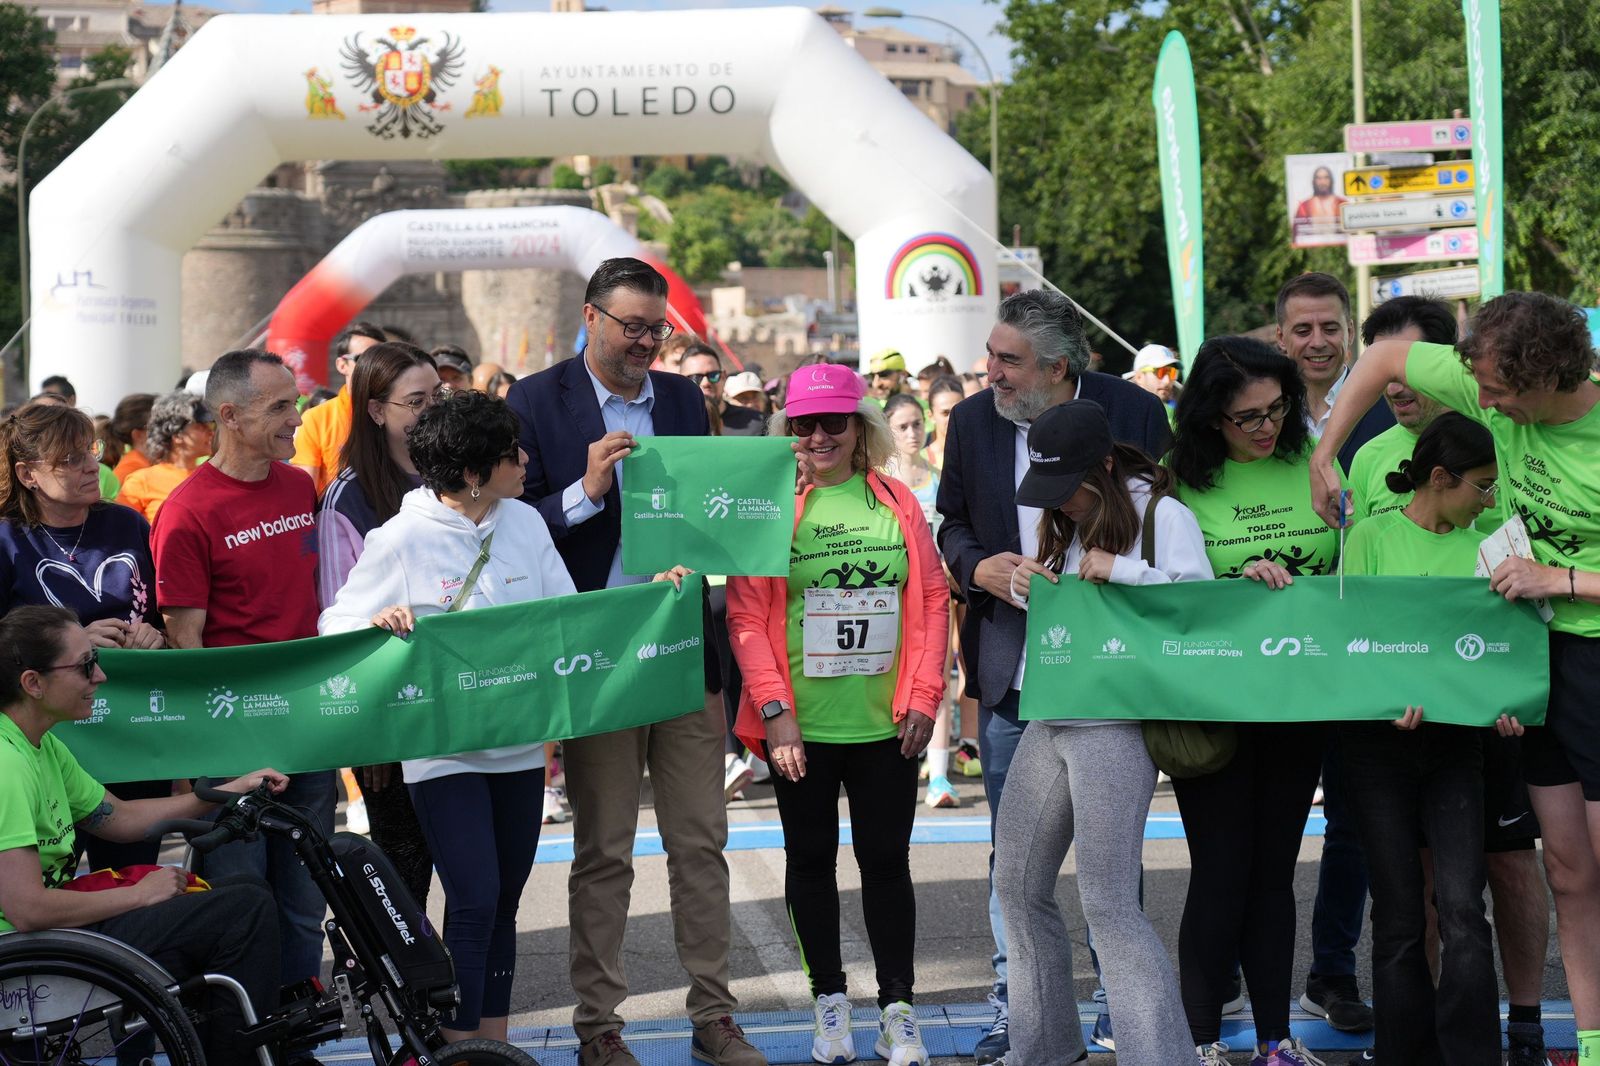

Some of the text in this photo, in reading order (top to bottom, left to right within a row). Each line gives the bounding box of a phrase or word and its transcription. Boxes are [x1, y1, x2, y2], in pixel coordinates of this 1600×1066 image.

[540, 62, 733, 79] AYUNTAMIENTO DE
[540, 84, 735, 117] TOLEDO
[511, 234, 561, 257] 2024
[1238, 506, 1293, 521] UNIVERSO MUJER
[1534, 495, 1544, 505] LA
[1545, 500, 1591, 519] IGUALDAD
[634, 511, 663, 519] Castilla-La
[817, 528, 849, 540] UNIVERSO
[1246, 522, 1286, 534] TOLEDO
[224, 526, 261, 549] new
[1216, 537, 1251, 547] FORMA
[1253, 533, 1272, 542] POR
[1274, 531, 1285, 539] LA
[1287, 526, 1329, 537] IGUALDAD
[825, 539, 863, 549] TOLEDO
[798, 551, 830, 562] FORMA
[863, 544, 902, 553] IGUALDAD
[837, 619, 869, 650] 57
[659, 635, 700, 655] Iberdrola
[1183, 639, 1233, 648] FUNDACIÓN
[1372, 641, 1429, 654] Iberdrola
[1182, 648, 1243, 657] DEPORTE JOVEN
[1040, 655, 1071, 665] TOLEDO
[478, 663, 526, 678] FUNDACIÓN
[479, 672, 537, 688] DEPORTE JOVEN
[254, 700, 289, 708] MANCHA
[320, 704, 359, 716] TOLEDO
[130, 714, 185, 723] Castilla-La Mancha
[273, 707, 289, 716] 2024
